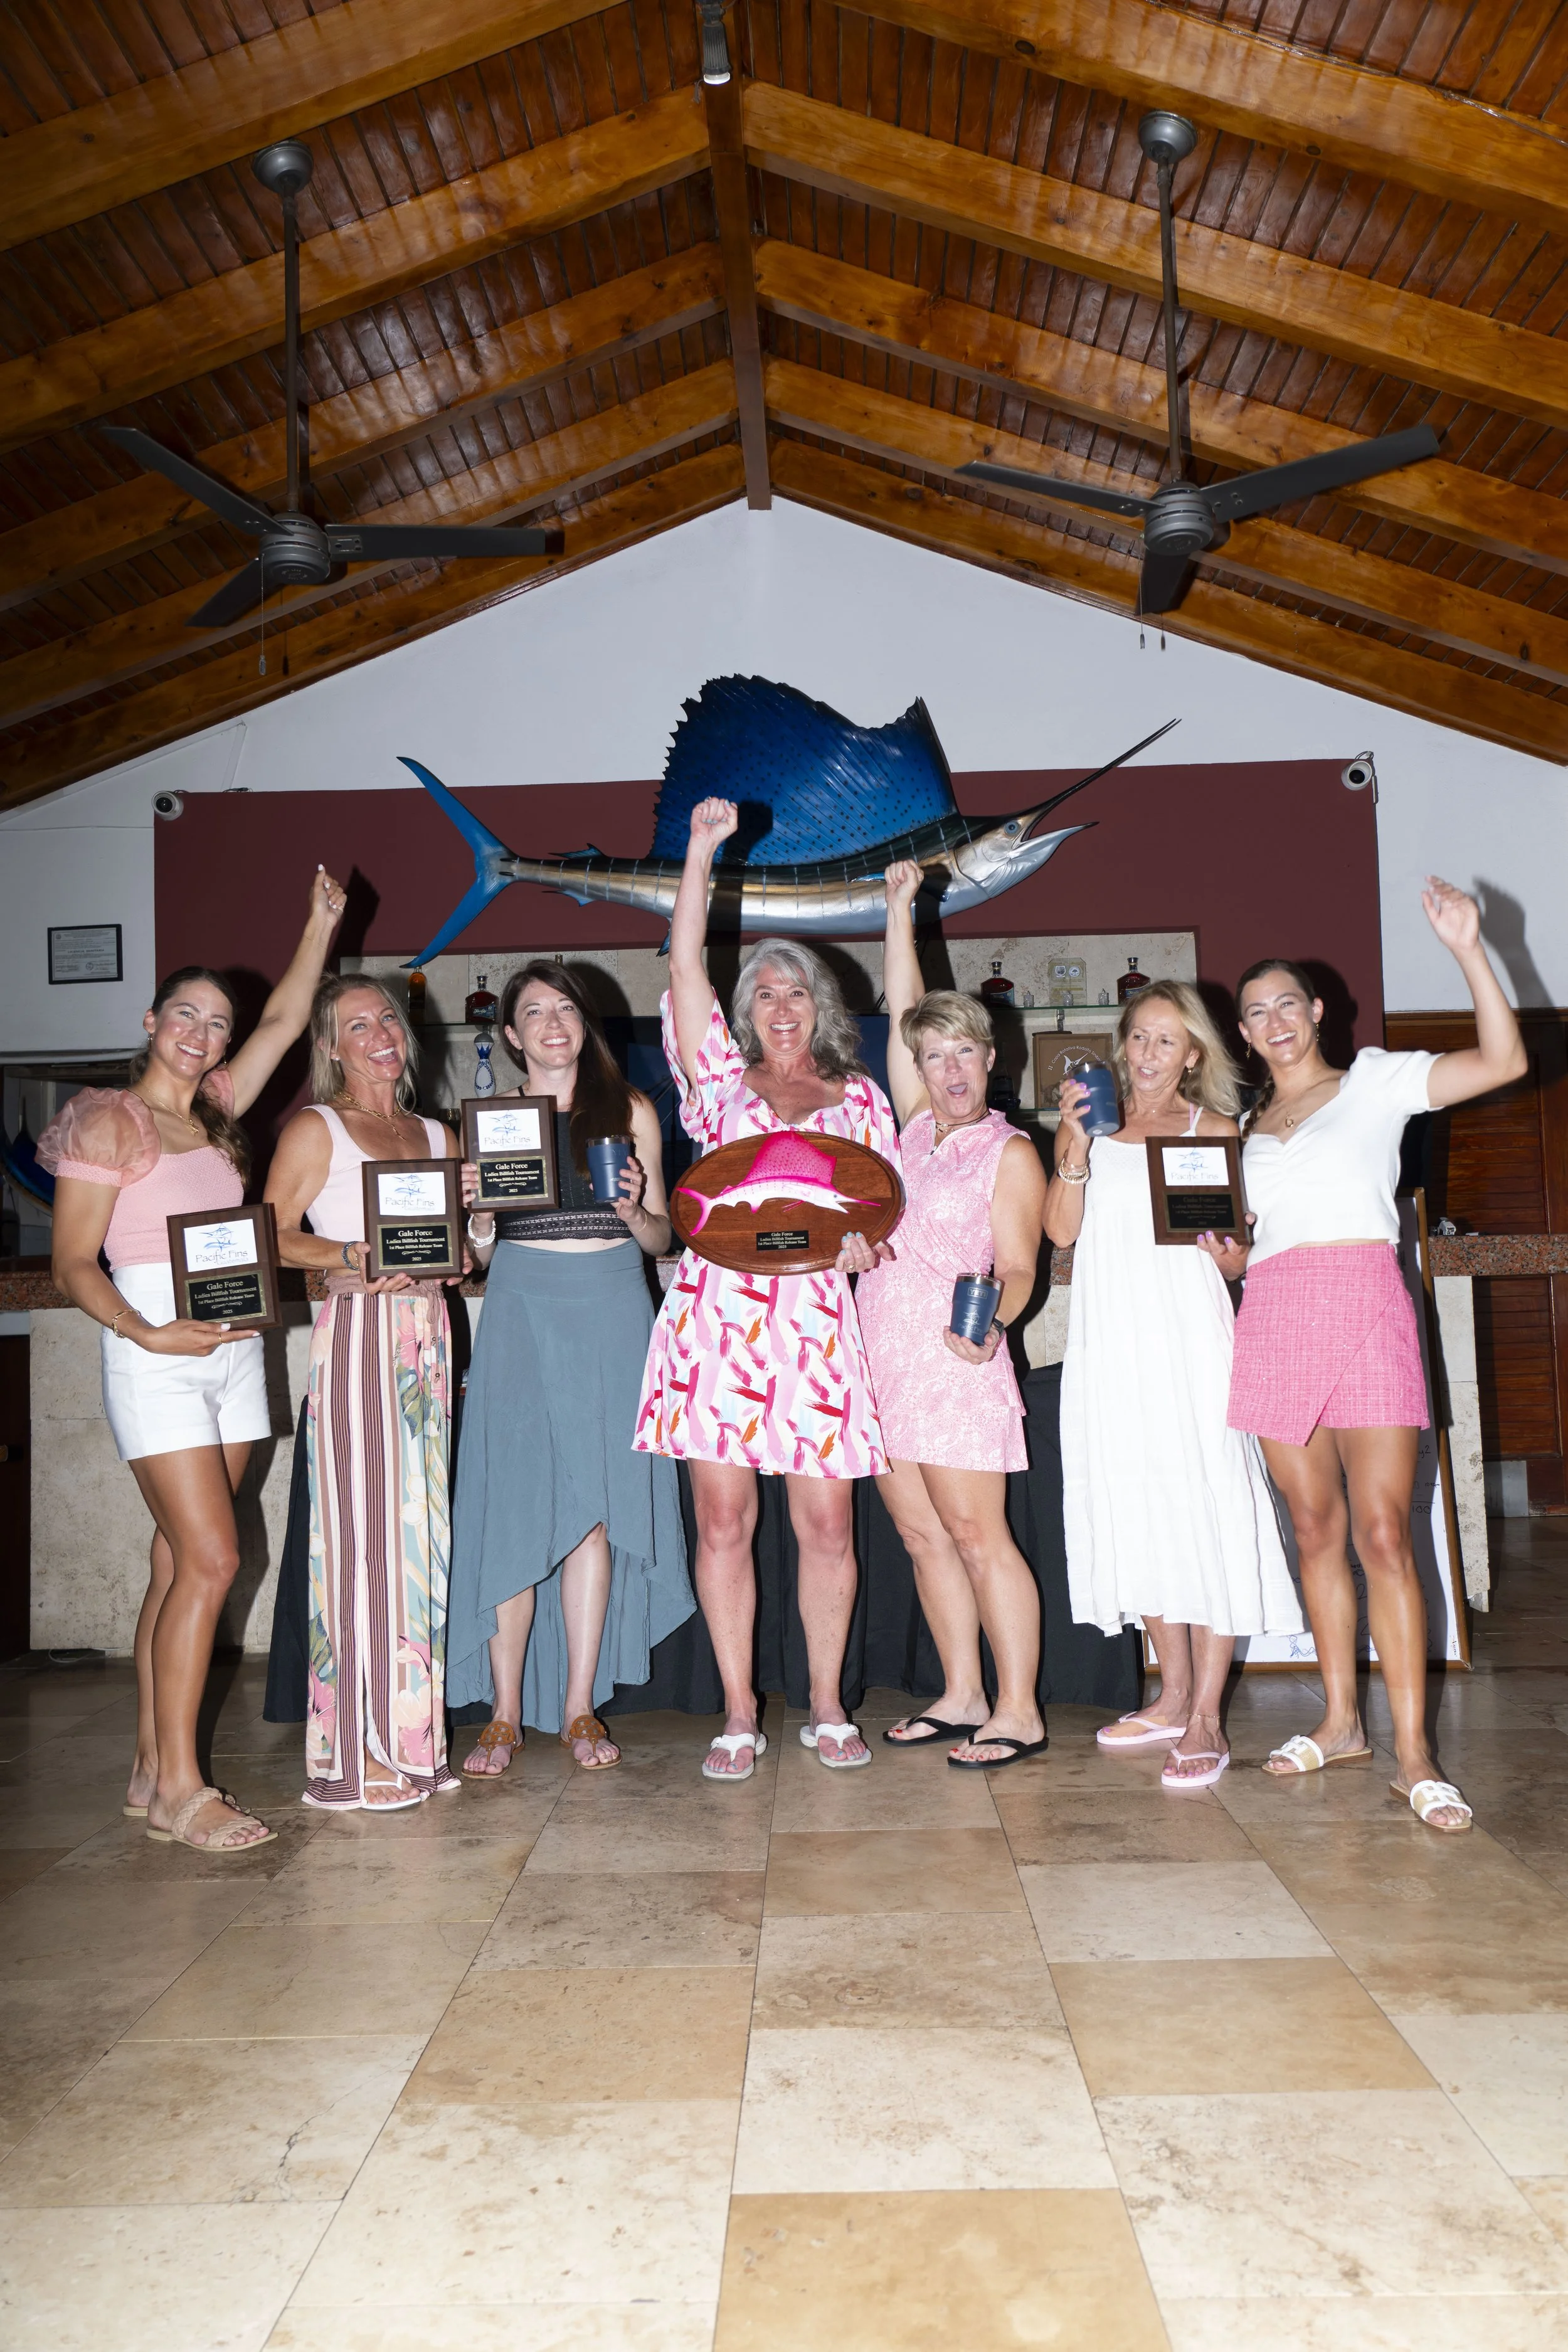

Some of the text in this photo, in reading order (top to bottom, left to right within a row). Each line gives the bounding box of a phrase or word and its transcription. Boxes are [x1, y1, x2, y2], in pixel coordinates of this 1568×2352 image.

[1059, 1046, 1076, 1054] Rotativa
[484, 1133, 511, 1145] Pacific
[385, 1195, 434, 1208] Pacific Fins
[195, 1249, 248, 1264] Pacific Fins
[206, 1280, 244, 1291] Gale Force
[970, 1288, 987, 1297] YETI
